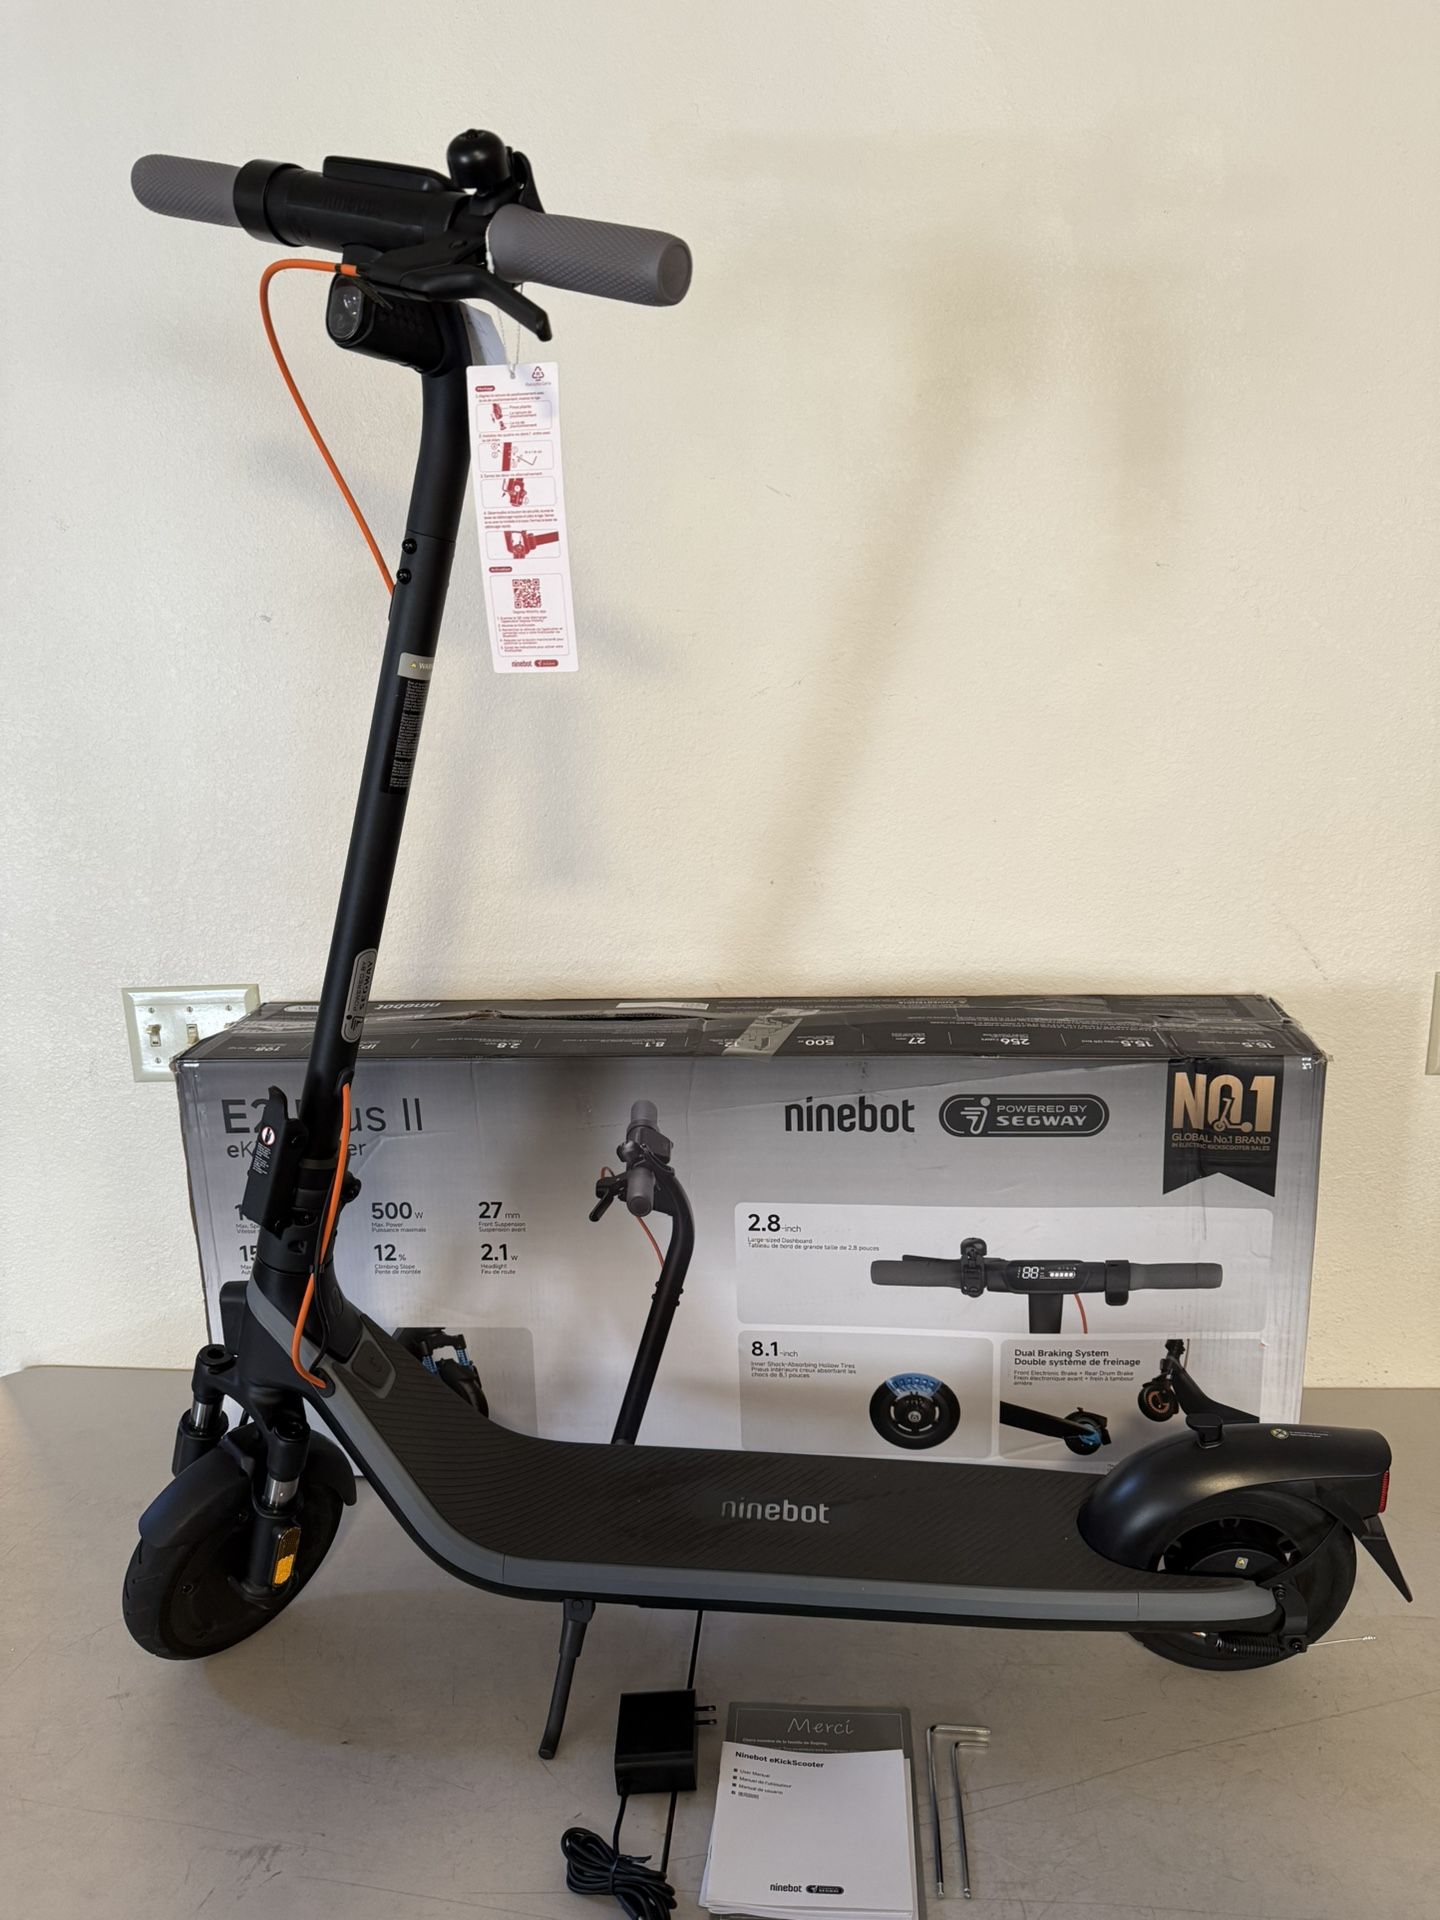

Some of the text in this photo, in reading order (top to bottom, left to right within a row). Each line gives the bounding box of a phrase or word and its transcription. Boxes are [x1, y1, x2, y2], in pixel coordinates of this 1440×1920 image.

[352, 974, 364, 1012] POWERED
[359, 960, 373, 1010] SEGWAY
[374, 1002, 440, 1010] ninebot
[785, 1096, 914, 1132] ninebot
[997, 1105, 1087, 1113] POWERED BY
[996, 1116, 1087, 1126] SEGWAY
[1172, 1132, 1270, 1144] GLOBAL No.1 BRAND
[372, 1202, 412, 1219] 500
[479, 1202, 502, 1218] 27
[374, 1244, 397, 1261] 12
[481, 1244, 507, 1260] 2.1
[1038, 1350, 1072, 1358] Braking
[1075, 1350, 1109, 1358] System
[1050, 1358, 1086, 1367] système
[1104, 1358, 1140, 1367] freinage
[722, 1497, 829, 1524] ninebot
[787, 1718, 853, 1735] Merci
[735, 1751, 824, 1768] Ninebot eKickScooter
[770, 1882, 802, 1893] ninebot
